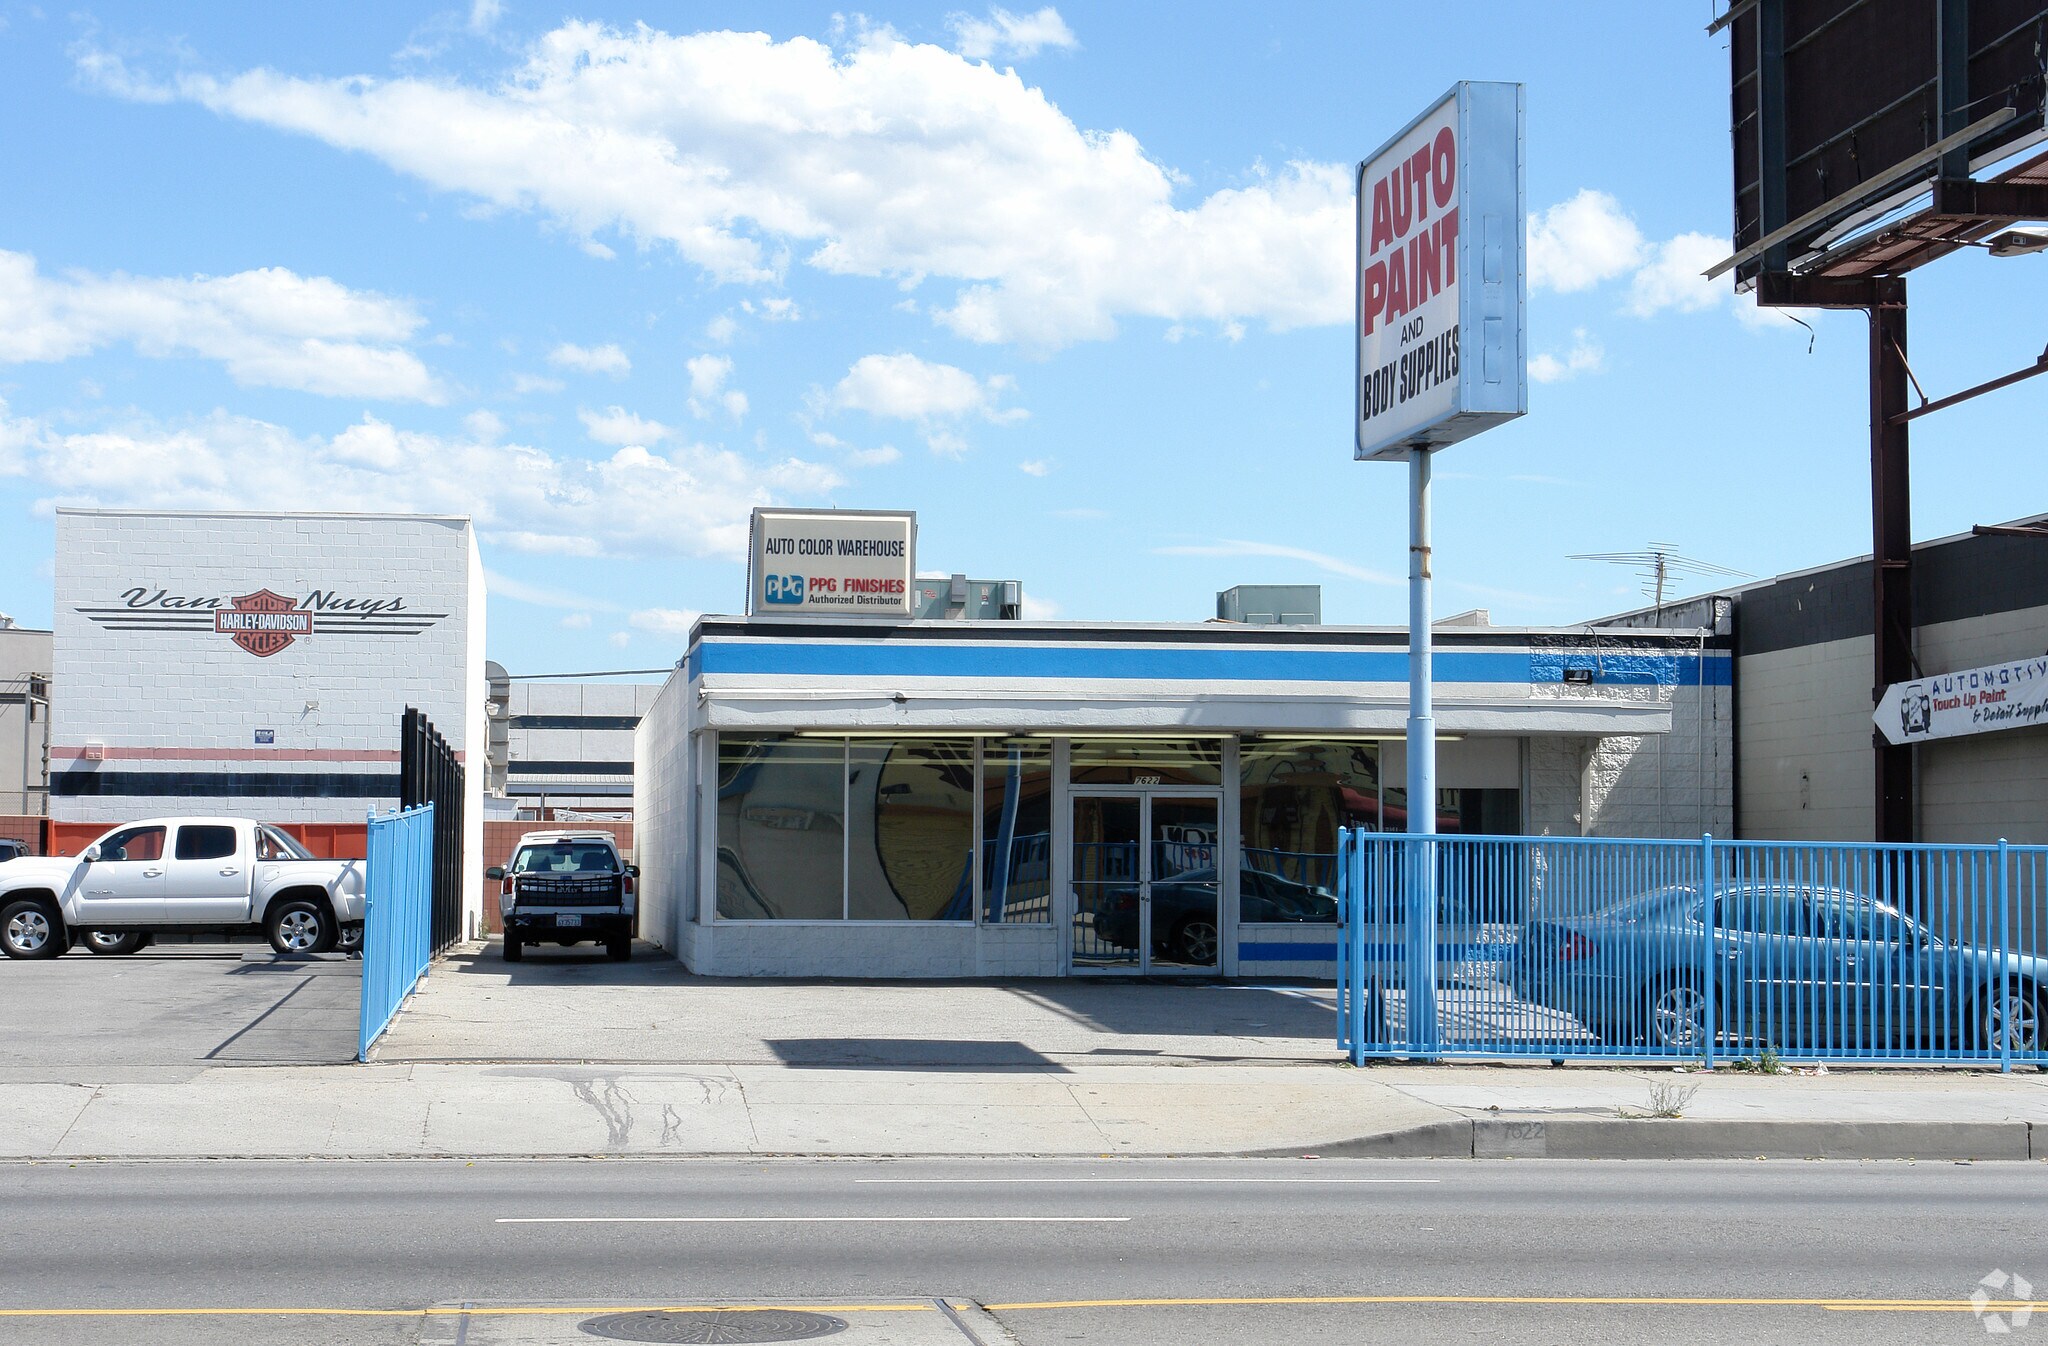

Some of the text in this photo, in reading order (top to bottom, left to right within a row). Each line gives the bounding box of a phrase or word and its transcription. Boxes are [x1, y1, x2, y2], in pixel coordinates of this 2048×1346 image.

[1370, 126, 1455, 256] AUTO
[1364, 206, 1459, 337] PAINT
[1400, 315, 1424, 347] AND
[1363, 324, 1459, 421] BODY SUPPLIES
[765, 538, 904, 557] AUTO COLOR WAREHOUSE
[767, 574, 803, 599] PPG
[809, 577, 905, 593] PPG FINISHES
[120, 587, 408, 619] Van Nuys
[240, 597, 287, 611] MOTOR
[809, 594, 902, 605] Authorized Distributor
[220, 613, 308, 631] HARLEY-DAVIDSON
[240, 632, 285, 651] CYCLES
[1932, 694, 1961, 712] Touch
[1963, 692, 1977, 709] Up
[1979, 688, 2007, 704] Paint
[1972, 709, 1981, 723] &
[1983, 703, 2014, 722] Detail
[1136, 776, 1159, 785] 7622
